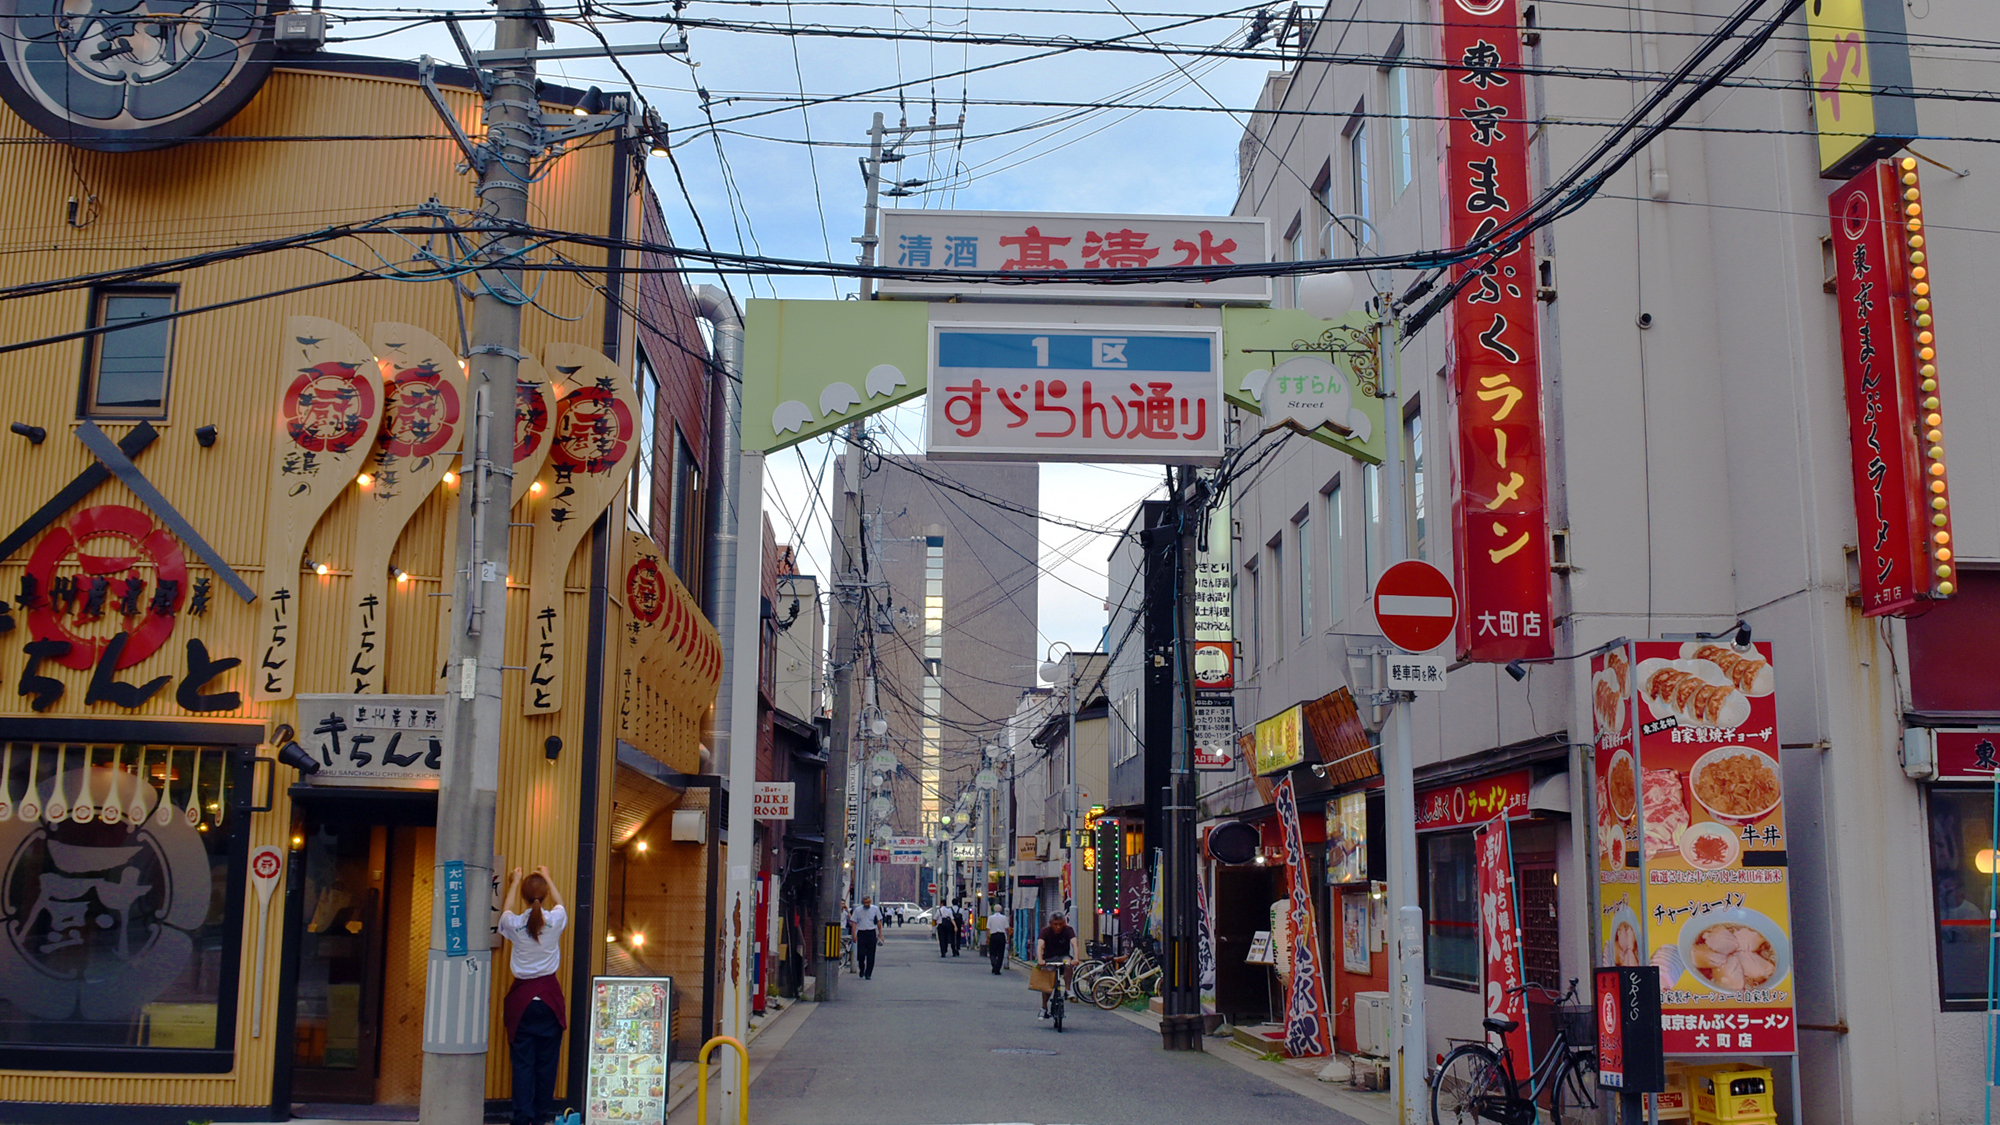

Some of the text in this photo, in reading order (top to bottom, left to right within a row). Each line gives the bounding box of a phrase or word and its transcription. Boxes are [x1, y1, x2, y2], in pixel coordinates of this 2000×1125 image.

[898, 234, 979, 267] 清酒
[1277, 374, 1342, 394] すずらん
[1287, 400, 1324, 409] Street
[1851, 244, 1894, 585] 東京まんぷくラーメン
[1873, 586, 1902, 606] 大町店
[1477, 609, 1541, 637] 大町店
[262, 587, 291, 693] きちんと
[0, 601, 243, 714] ちんと
[530, 606, 558, 709] きちんと
[1392, 664, 1443, 682] 軽車両を除く
[355, 706, 444, 729] 奥州産直厨
[1642, 717, 1676, 735] 東京名物
[1671, 726, 1773, 744] 自家製焼ギョーザ
[754, 794, 789, 804] DUKE
[753, 806, 789, 815] ROOM
[1741, 824, 1782, 848] 牛丼
[1650, 869, 1783, 885] 厳選された牛バラ肉と秋田産新米
[449, 869, 461, 949] 大町三丁目 2
[1653, 891, 1747, 925] チャーシューメン
[1661, 1014, 1790, 1032] 東京まんぷくラーメン
[1695, 1033, 1753, 1048] 大町店
